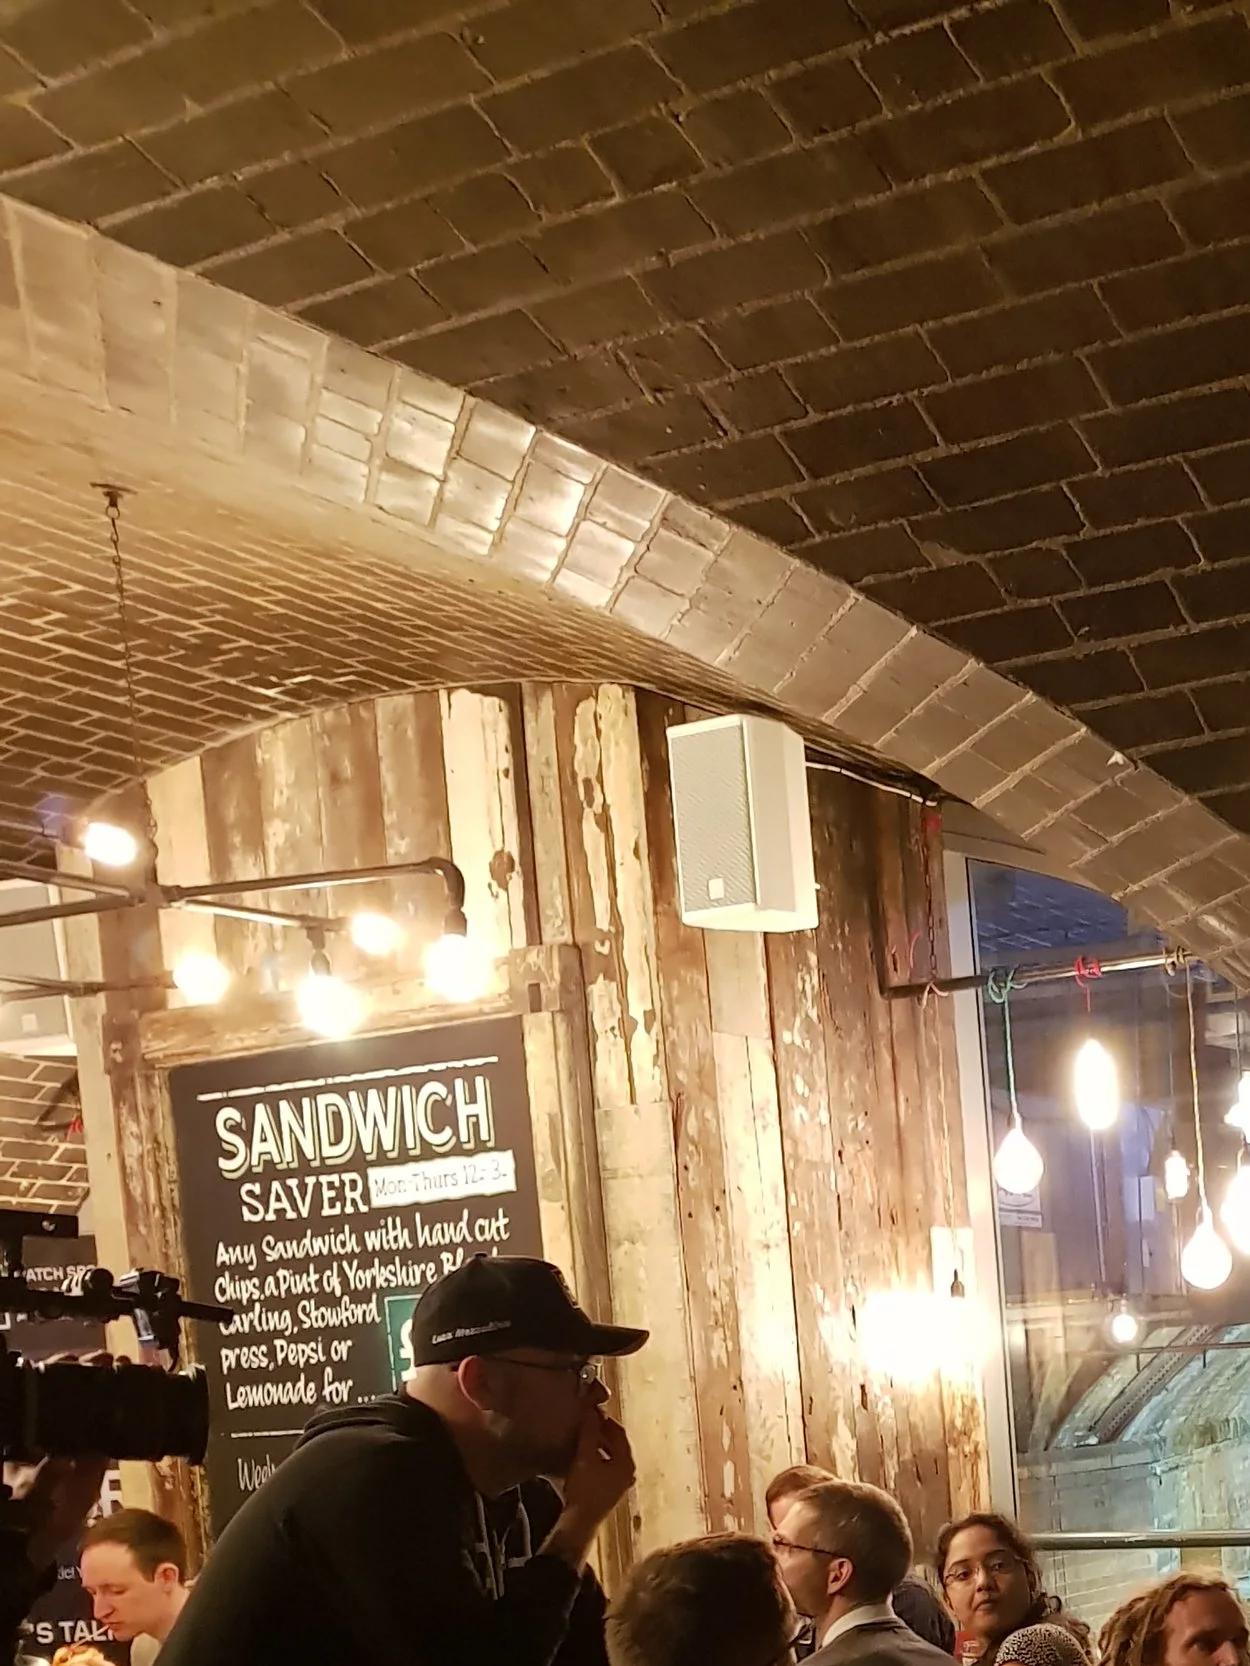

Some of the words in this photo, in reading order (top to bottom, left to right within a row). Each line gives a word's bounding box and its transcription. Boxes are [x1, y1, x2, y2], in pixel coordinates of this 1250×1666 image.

[215, 1075, 495, 1180] SANDWICH
[240, 1171, 369, 1222] SAVER
[216, 1241, 257, 1271] Any
[262, 1224, 361, 1262] Sandwich
[364, 1216, 413, 1252] with
[415, 1212, 473, 1248] hand
[474, 1207, 510, 1242] cut
[22, 1266, 64, 1282] ATCH
[276, 1263, 319, 1299] Pint
[322, 1261, 341, 1297] of
[342, 1256, 437, 1291] Yorkshire
[298, 1293, 381, 1329] Stowford
[220, 1344, 274, 1375] press,
[273, 1336, 326, 1369] Pepsi
[330, 1339, 352, 1362] or
[226, 1373, 317, 1411] Lemonade
[322, 1366, 353, 1403] for
